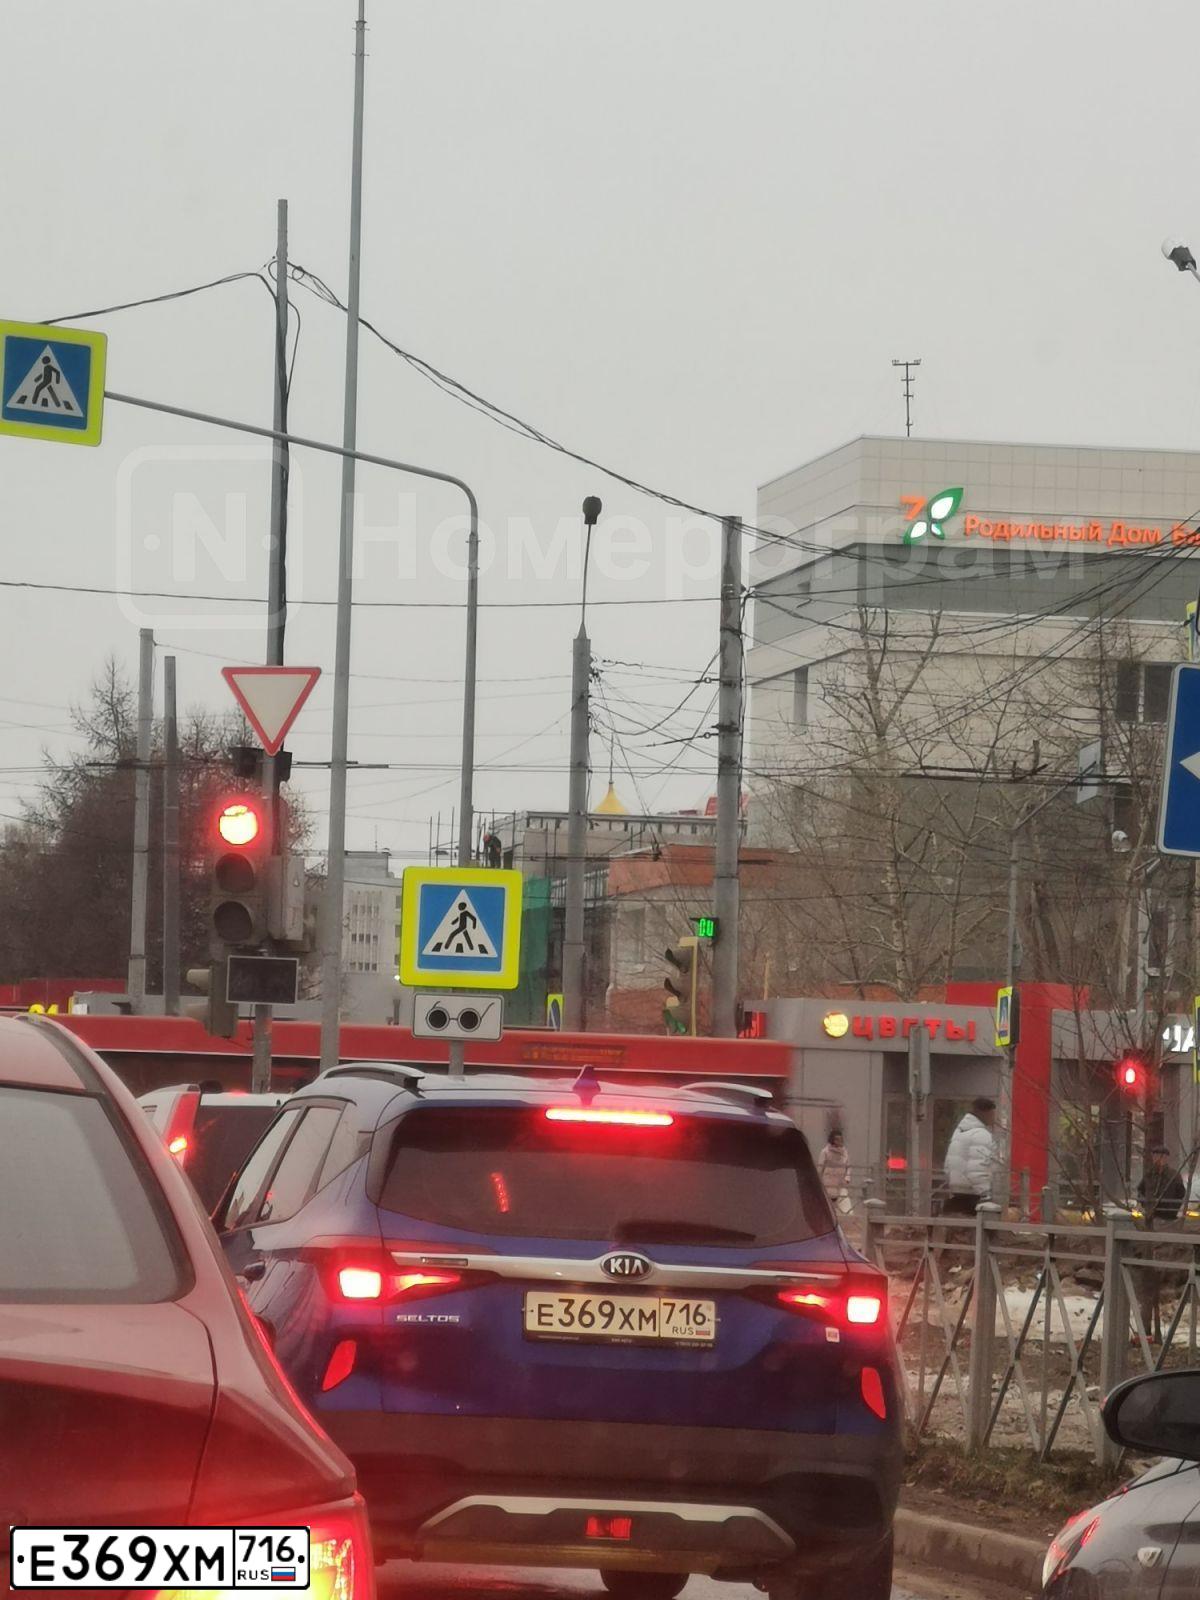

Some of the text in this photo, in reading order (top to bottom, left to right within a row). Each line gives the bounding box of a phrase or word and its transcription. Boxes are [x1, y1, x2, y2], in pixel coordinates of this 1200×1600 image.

[963, 513, 1103, 543] Родильный
[1107, 521, 1161, 547] Дом
[610, 1257, 650, 1275] KIA
[396, 1314, 461, 1323] SELTOS
[537, 1298, 707, 1332] Е369ХМ 716
[671, 1326, 695, 1336] RUS
